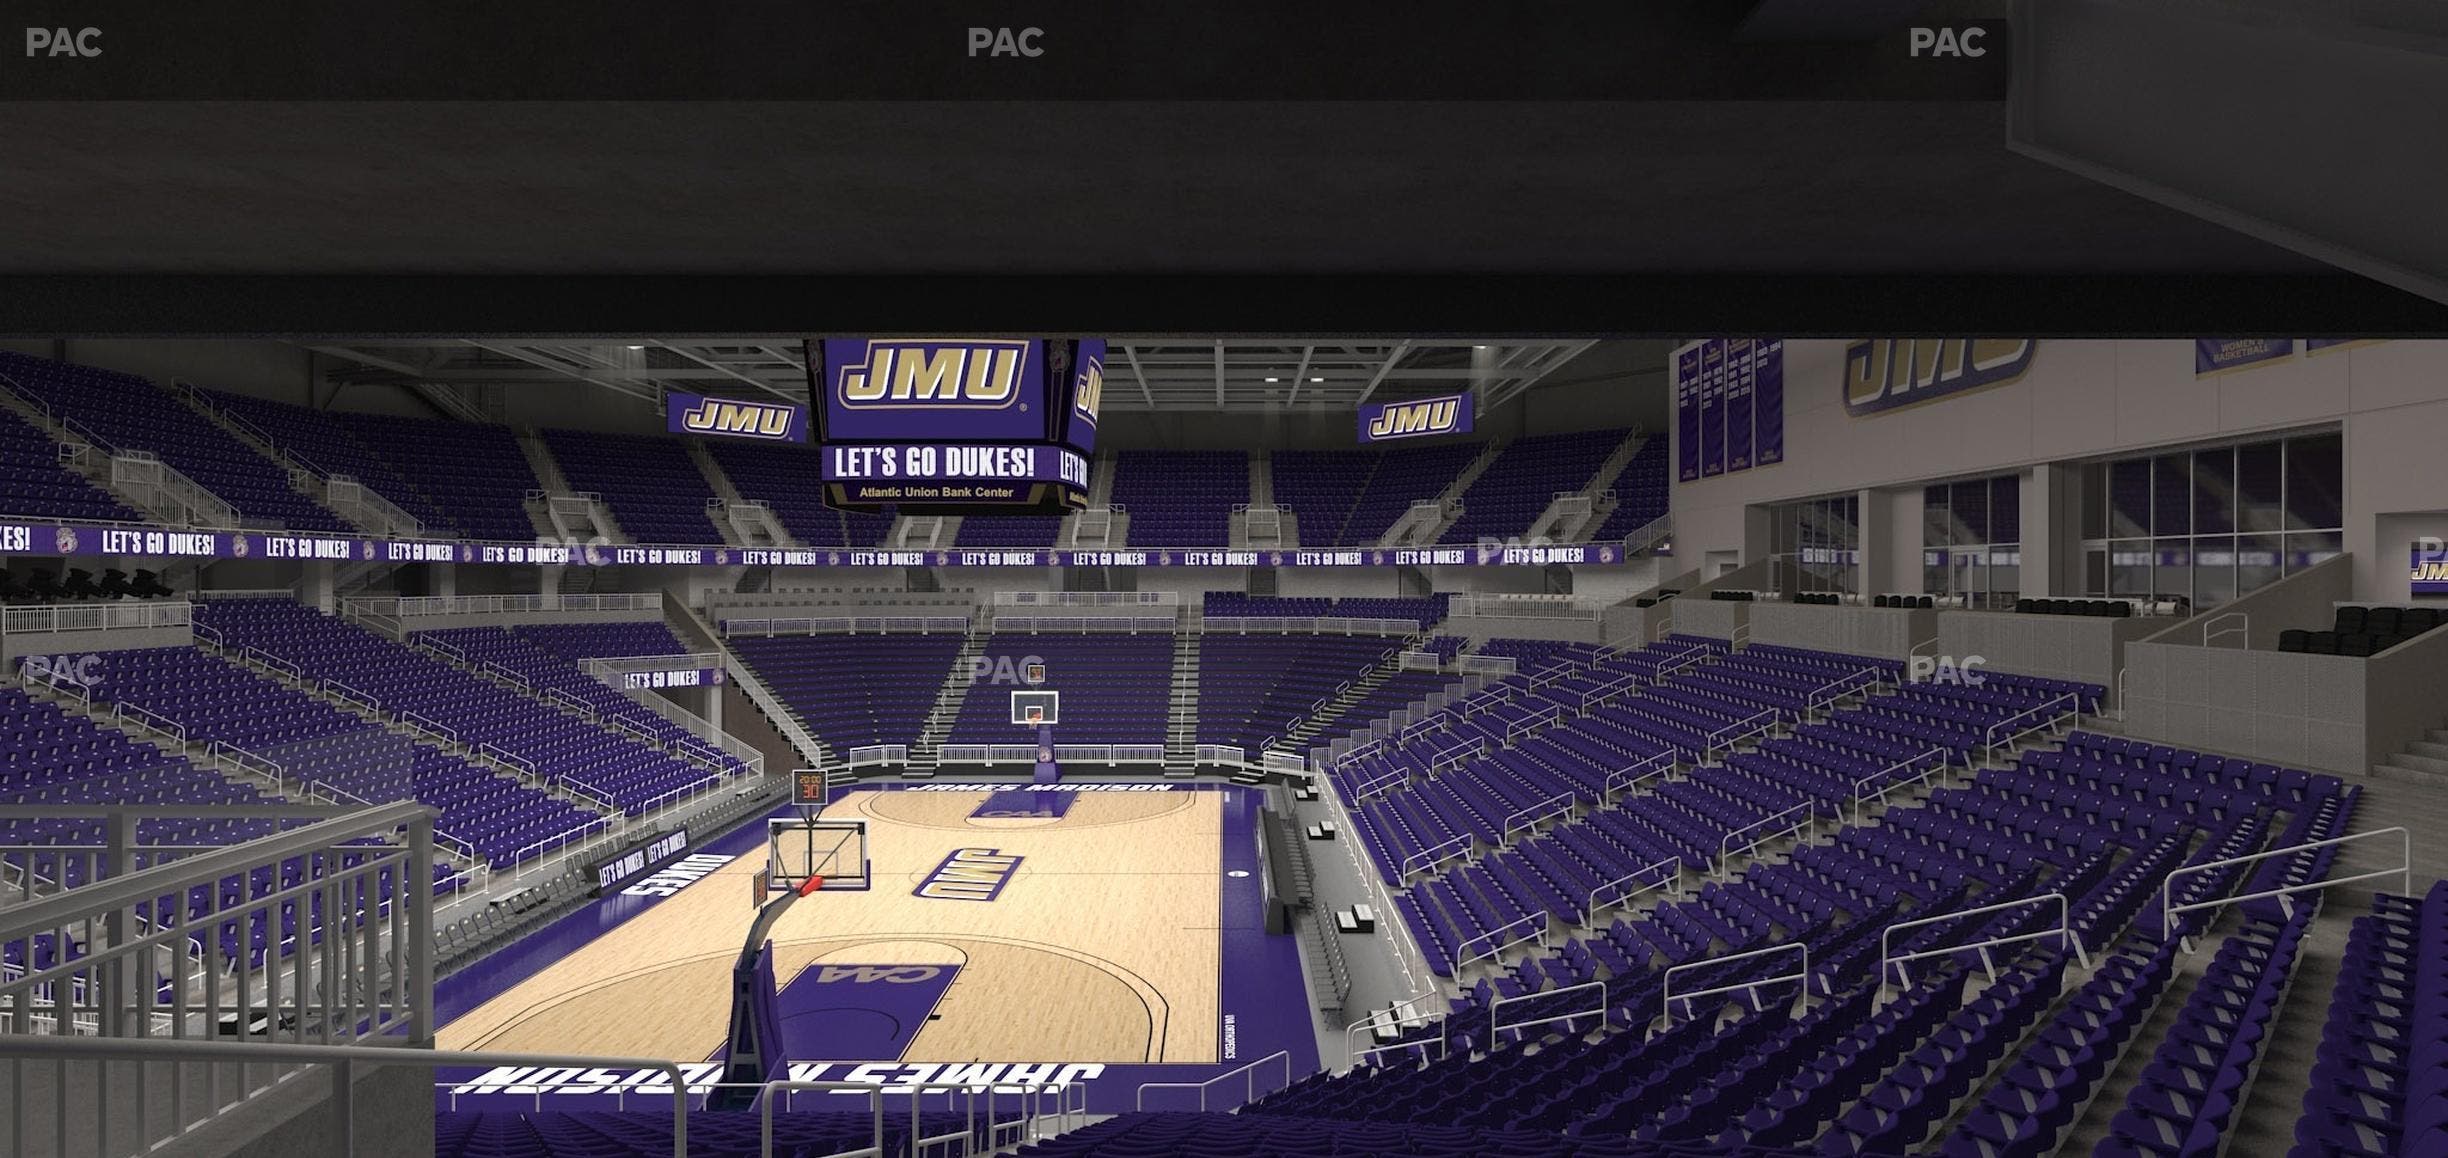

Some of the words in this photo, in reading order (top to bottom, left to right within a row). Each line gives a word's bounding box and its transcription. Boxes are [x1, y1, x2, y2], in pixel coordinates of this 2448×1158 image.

[846, 348, 1018, 400] JMU
[687, 402, 789, 435] JMU
[1372, 400, 1457, 435] JMU
[835, 447, 897, 477] LET'S
[905, 447, 937, 477] GO
[945, 446, 1035, 477] DUKES!
[859, 486, 901, 498] Atlantic
[905, 487, 938, 498] Union
[942, 487, 972, 498] Bank
[975, 487, 1014, 498] Center
[103, 530, 141, 554] LET'S
[146, 532, 164, 554] GO
[169, 533, 215, 556] DUKES!
[266, 538, 295, 557] LET'S
[299, 538, 312, 558] GO
[315, 540, 350, 559] DUKES!
[388, 542, 411, 560] LET'S
[413, 543, 424, 560] GO
[425, 544, 453, 561] DUKES!
[617, 549, 646, 564] LET'S
[648, 549, 662, 564] GO
[665, 549, 701, 565] DUKES!
[743, 551, 767, 565] LET'S
[770, 551, 782, 565] GO
[784, 551, 816, 566] DUKES!
[850, 552, 875, 566] LET'S
[877, 552, 889, 566] GO
[891, 552, 923, 566] DUKES!
[962, 553, 986, 566] LET'S
[988, 553, 1000, 566] GO
[1002, 553, 1035, 566] DUKES!
[1073, 553, 1098, 566] LET'S
[1100, 553, 1112, 566] GO
[1114, 553, 1146, 566] DUKES!
[1185, 552, 1209, 566] LET'S
[1211, 552, 1223, 566] GO
[1226, 552, 1258, 566] DUKES!
[1296, 552, 1320, 566] LET'S
[1322, 552, 1333, 566] GO
[1335, 552, 1362, 566] DUKES!
[1396, 551, 1418, 565] LET'S
[1420, 551, 1431, 565] GO
[1433, 550, 1465, 564] DUKES!
[652, 672, 665, 688] GO
[668, 670, 700, 686] DUKES!
[800, 775, 821, 784] 20:00
[906, 784, 1021, 792] JAMES
[1024, 784, 1174, 792] MADISON
[803, 784, 820, 799] 30
[599, 863, 616, 888] LET'S
[620, 853, 736, 896] DUKES
[920, 849, 1017, 900] JMU
[816, 966, 941, 984] CAA
[828, 1063, 1105, 1094] JAMES
